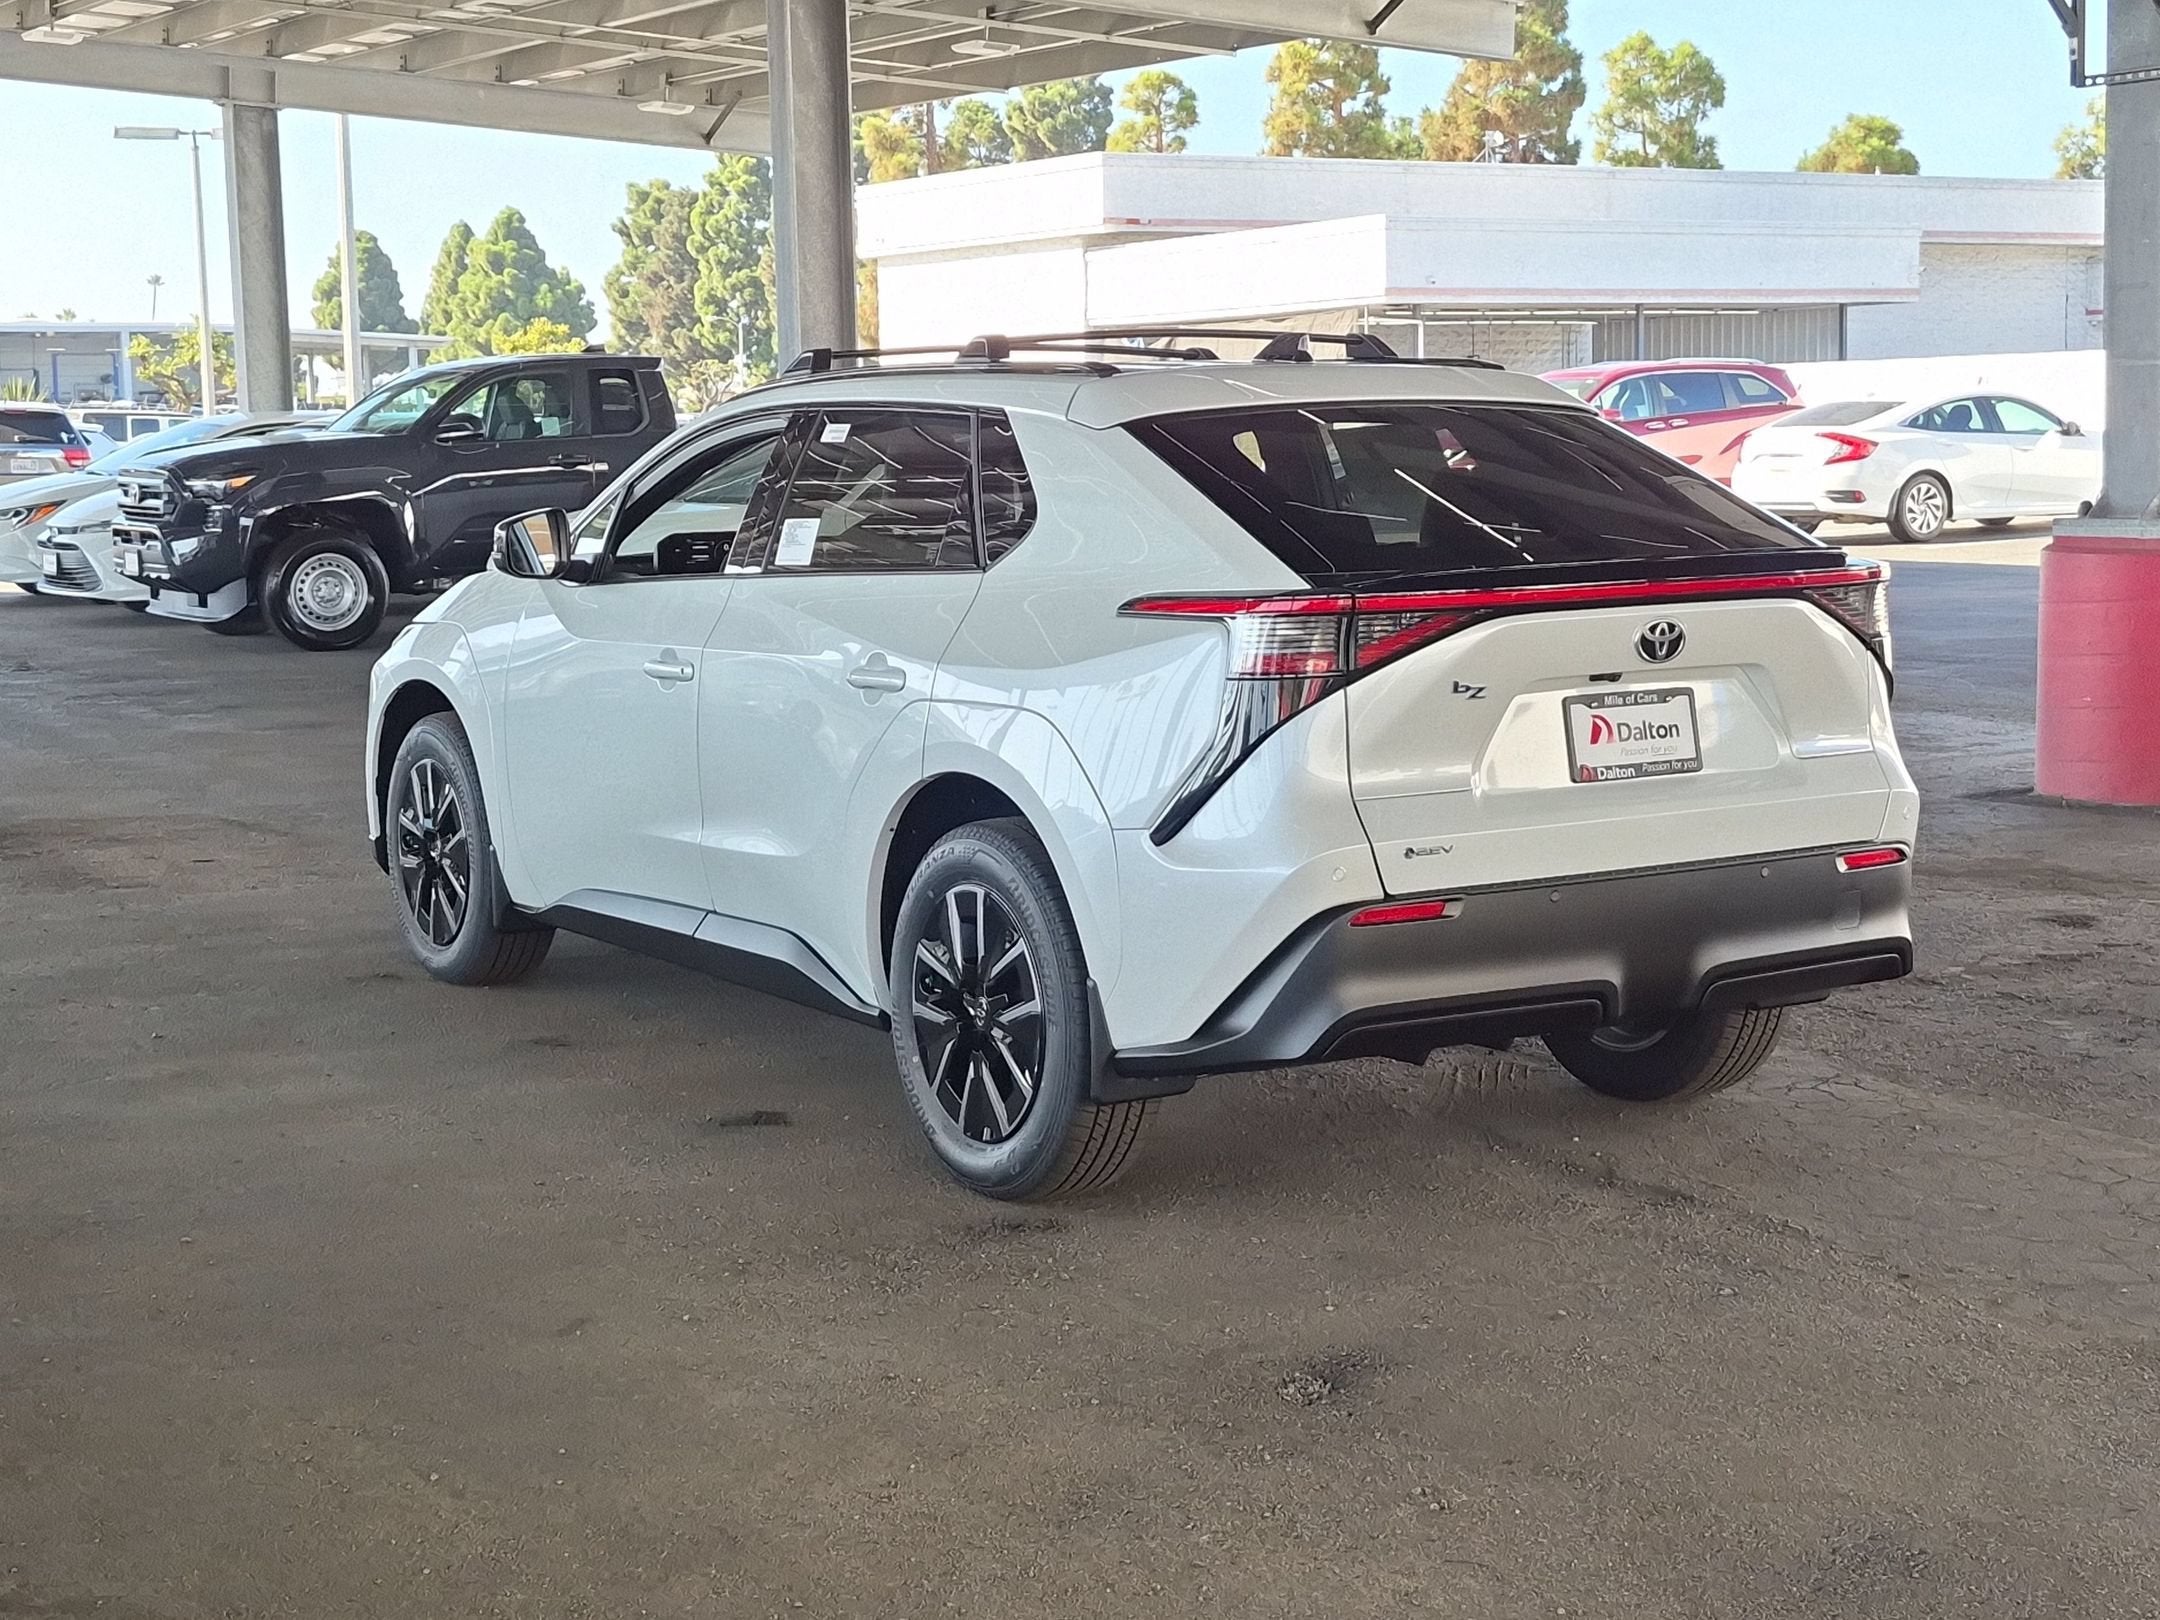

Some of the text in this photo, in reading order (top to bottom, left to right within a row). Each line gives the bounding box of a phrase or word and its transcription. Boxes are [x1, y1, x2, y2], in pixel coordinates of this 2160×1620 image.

[1604, 693, 1658, 706] Mile of Cars
[1616, 720, 1681, 742] Dalton
[1650, 743, 1663, 754] for
[1664, 744, 1678, 755] you
[1596, 759, 1698, 780] Dalton Passion for you
